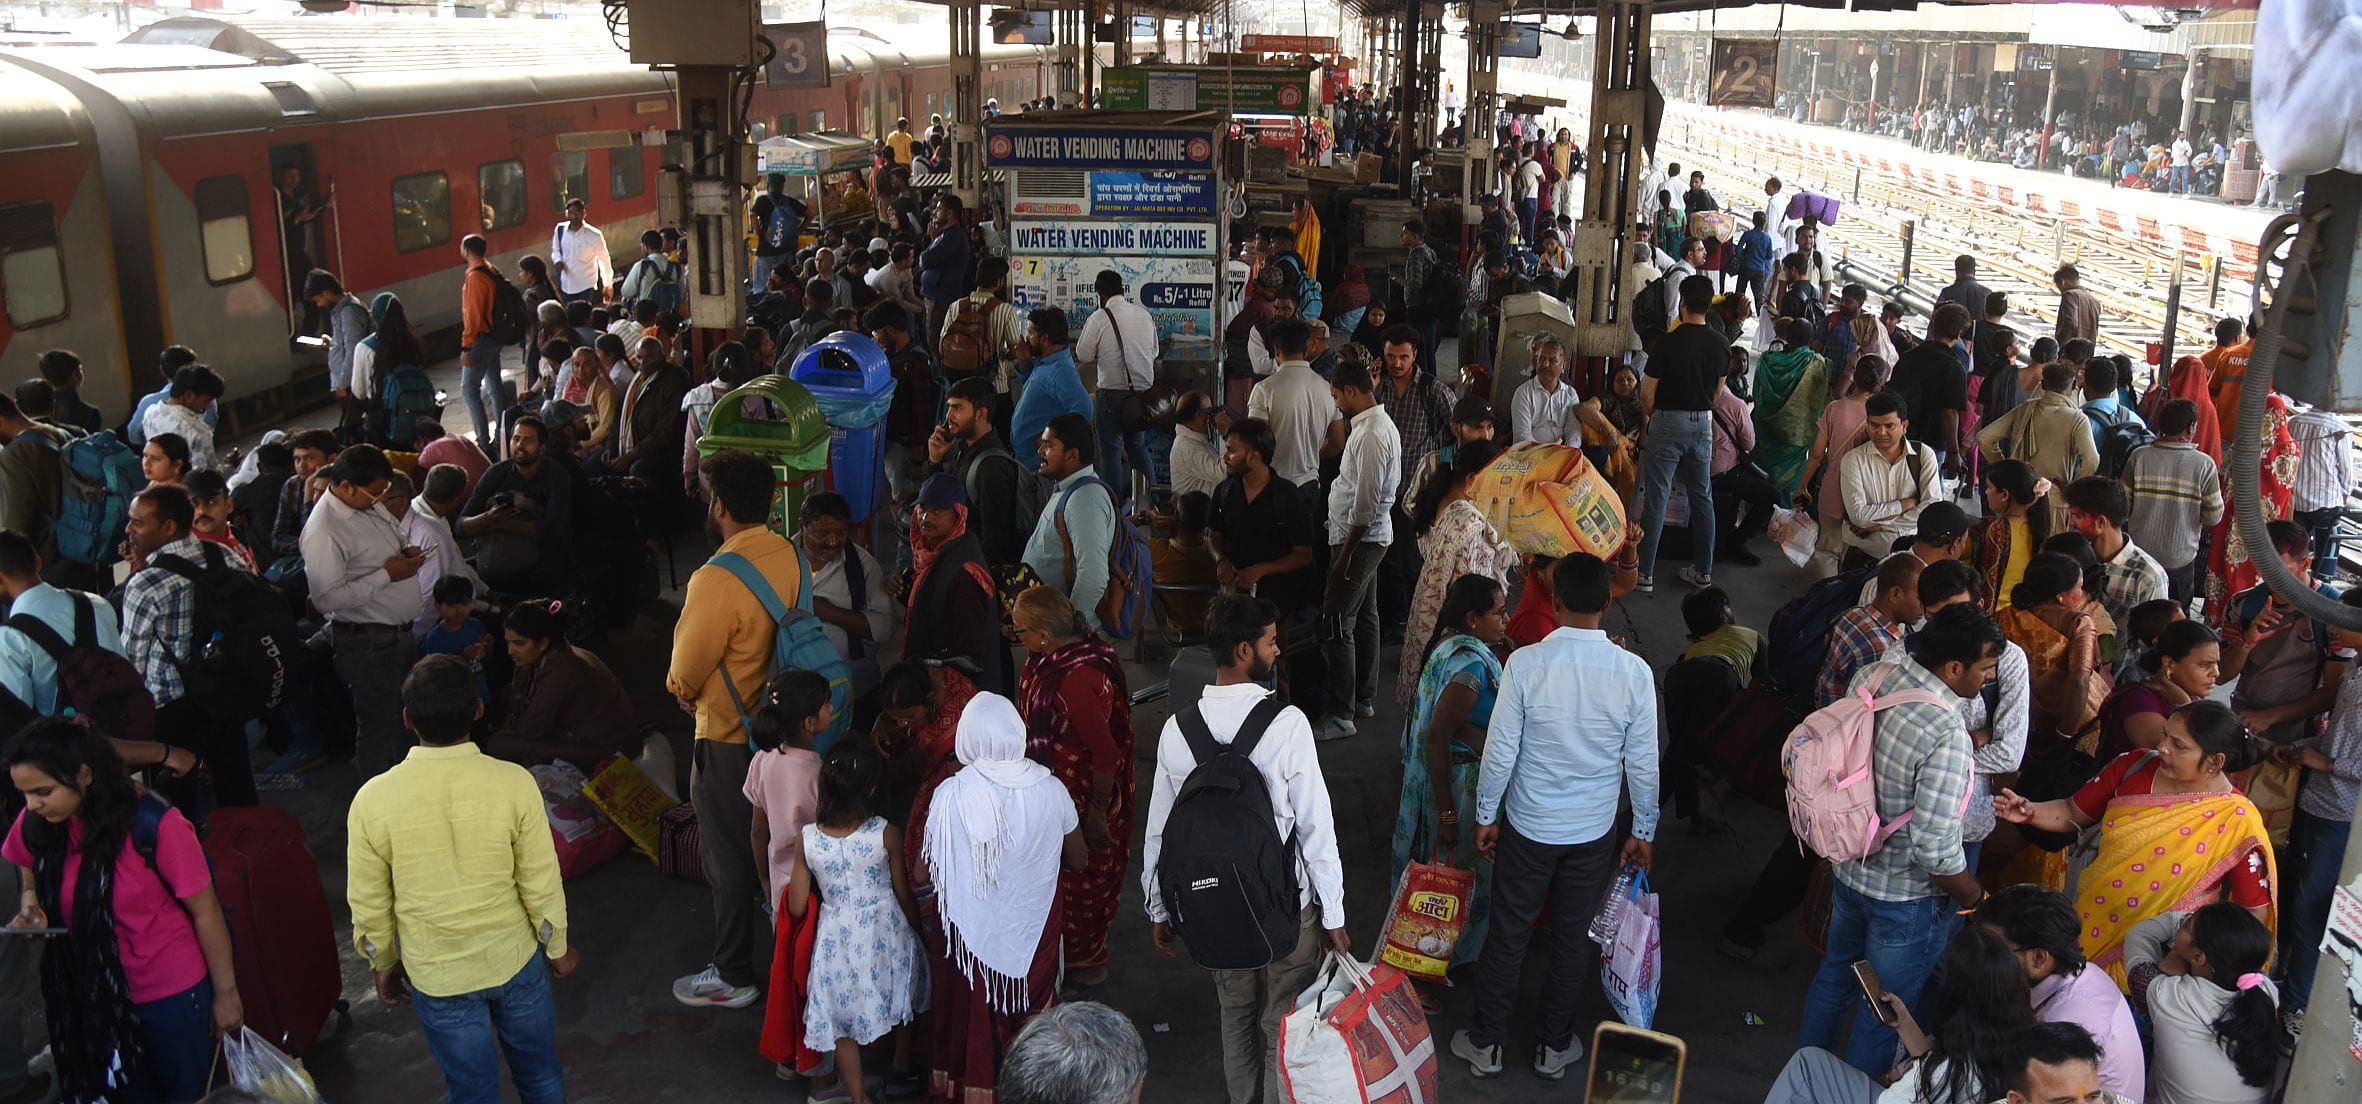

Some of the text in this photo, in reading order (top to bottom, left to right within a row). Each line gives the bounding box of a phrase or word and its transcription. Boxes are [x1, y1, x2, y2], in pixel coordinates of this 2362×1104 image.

[783, 37, 808, 74] 3
[1729, 55, 1757, 92] 2
[1014, 137, 1185, 161] WATER VENDING MACHINE
[1017, 228, 1207, 249] WATER VENDING MACHINE
[1029, 261, 1038, 275] 7
[1013, 284, 1028, 308] 5
[1189, 298, 1208, 307] Refill
[1191, 287, 1212, 299] Litre
[2228, 356, 2249, 366] KING
[1415, 901, 1449, 919] आटा
